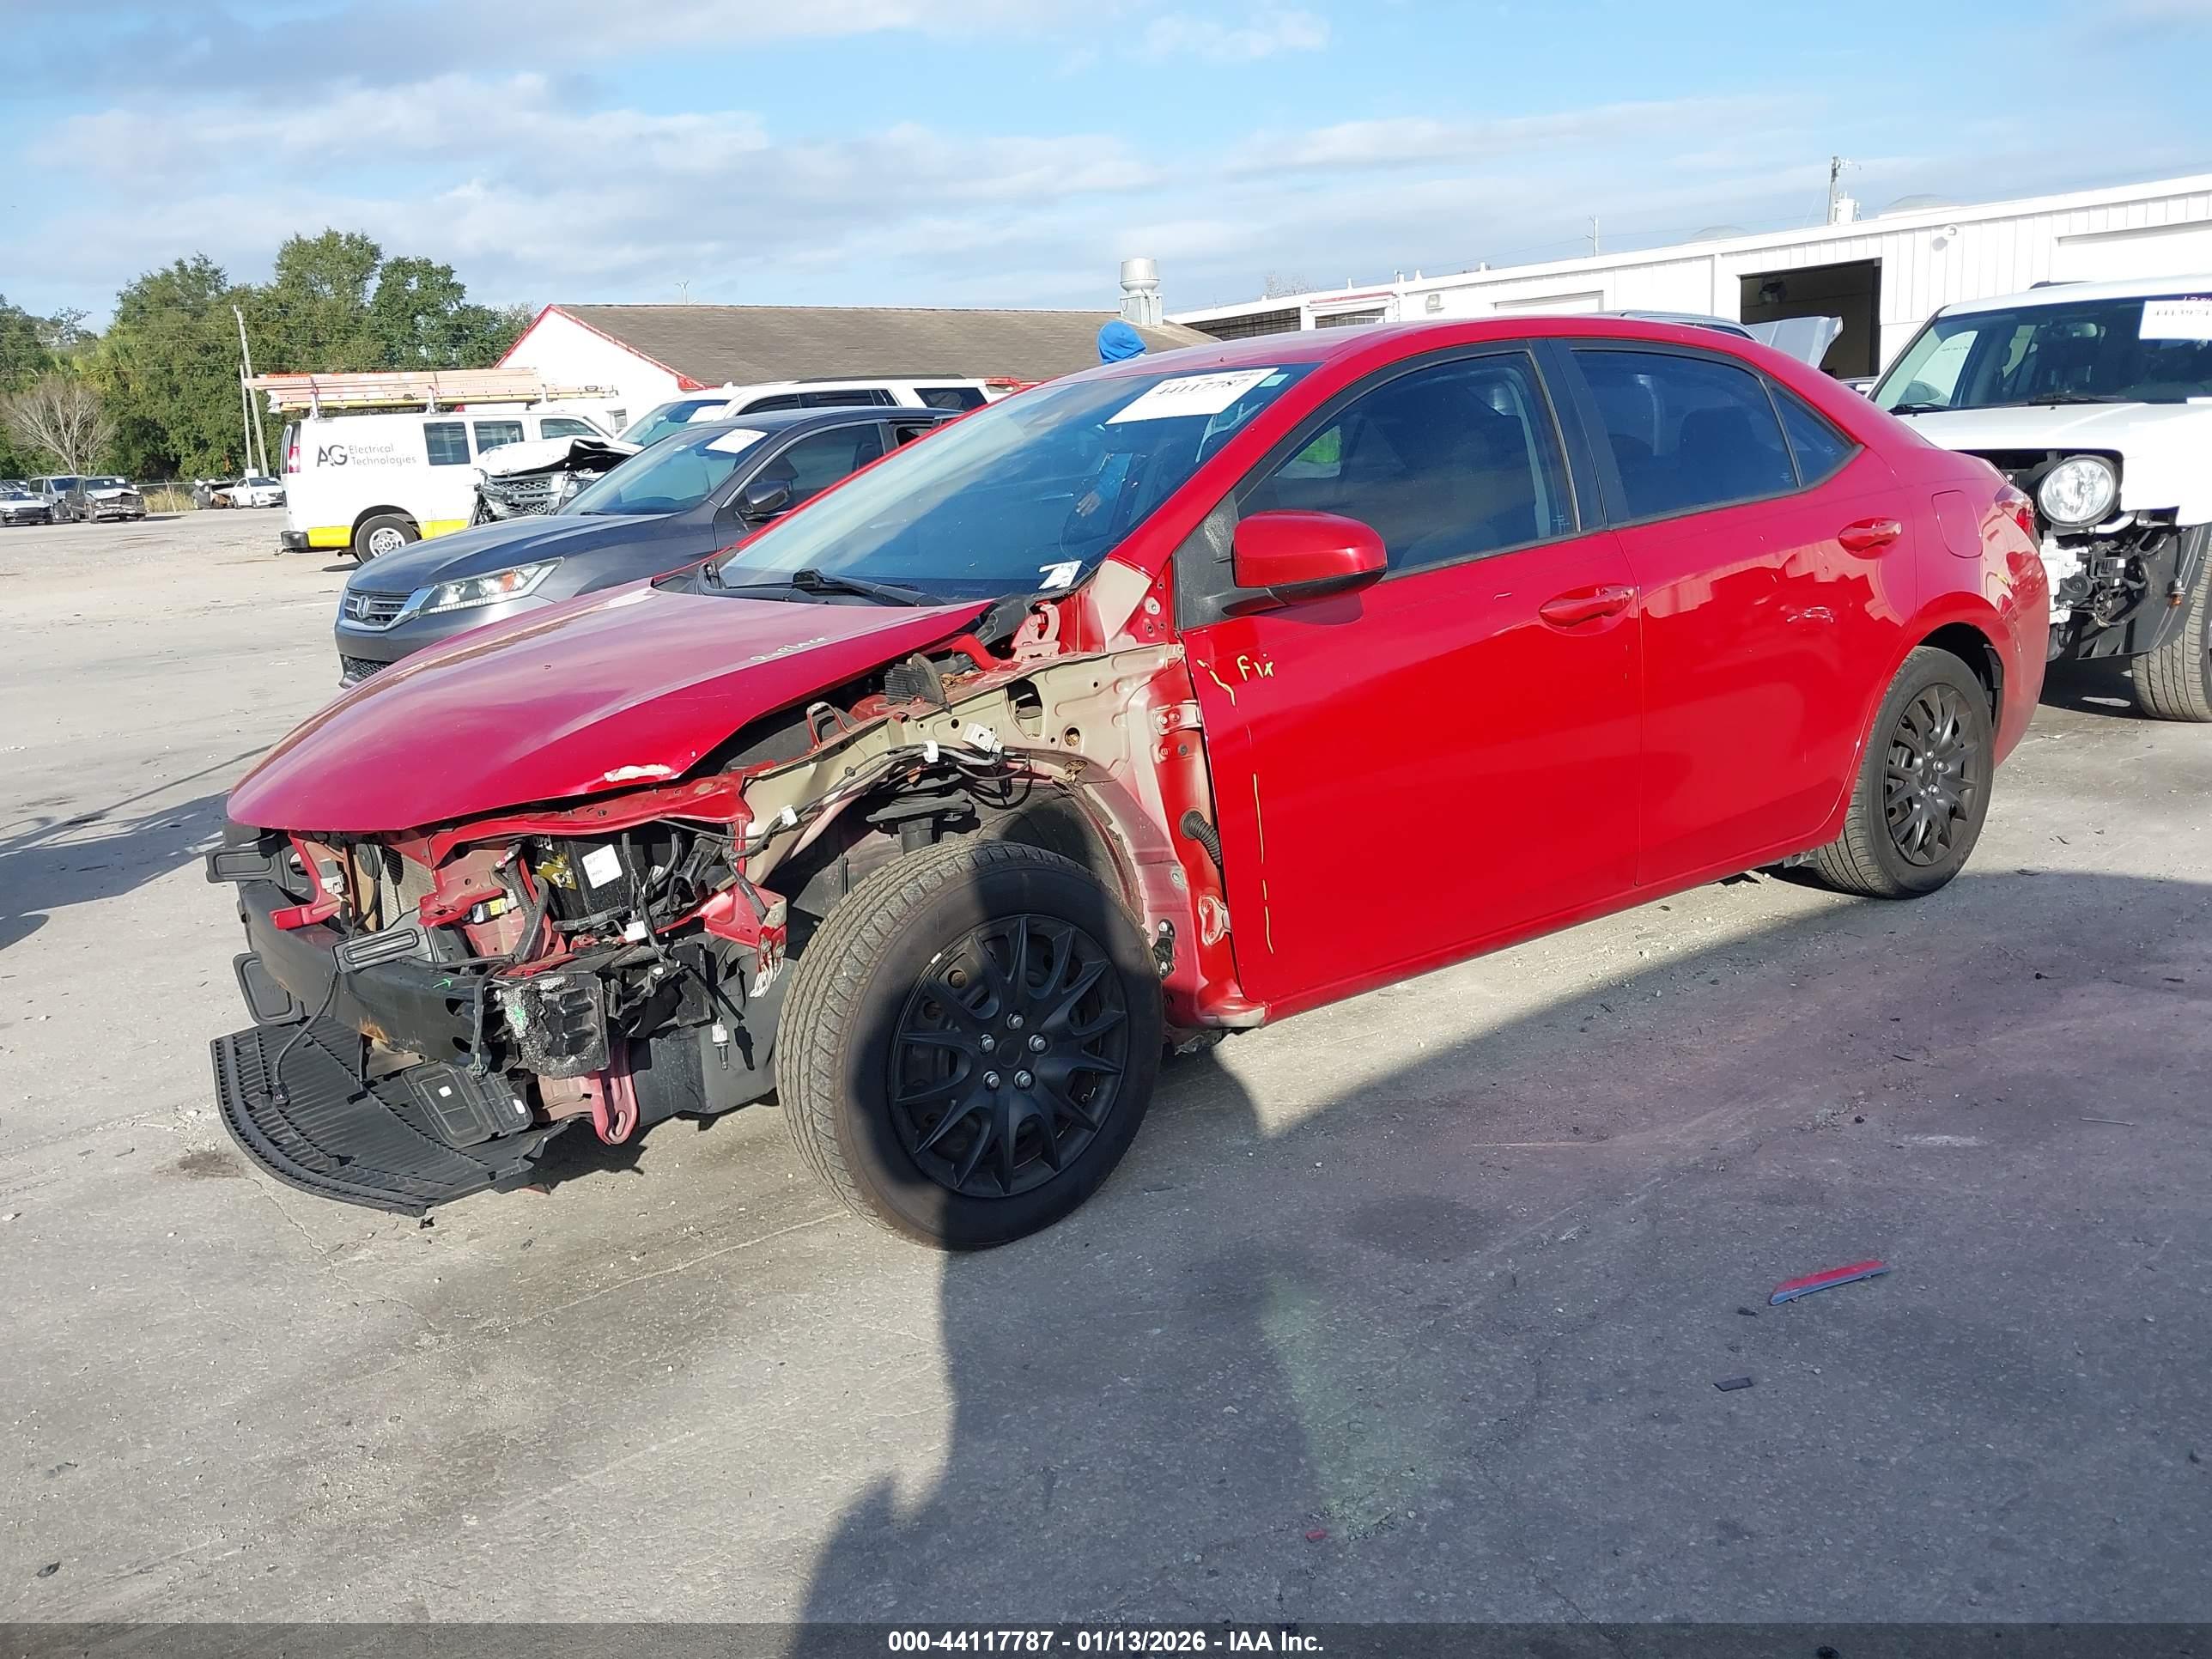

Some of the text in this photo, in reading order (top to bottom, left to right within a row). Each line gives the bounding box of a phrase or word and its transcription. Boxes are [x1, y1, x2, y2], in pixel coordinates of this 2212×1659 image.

[349, 444, 394, 454] Electrical
[317, 445, 348, 467] AG
[352, 455, 417, 467] Technologies
